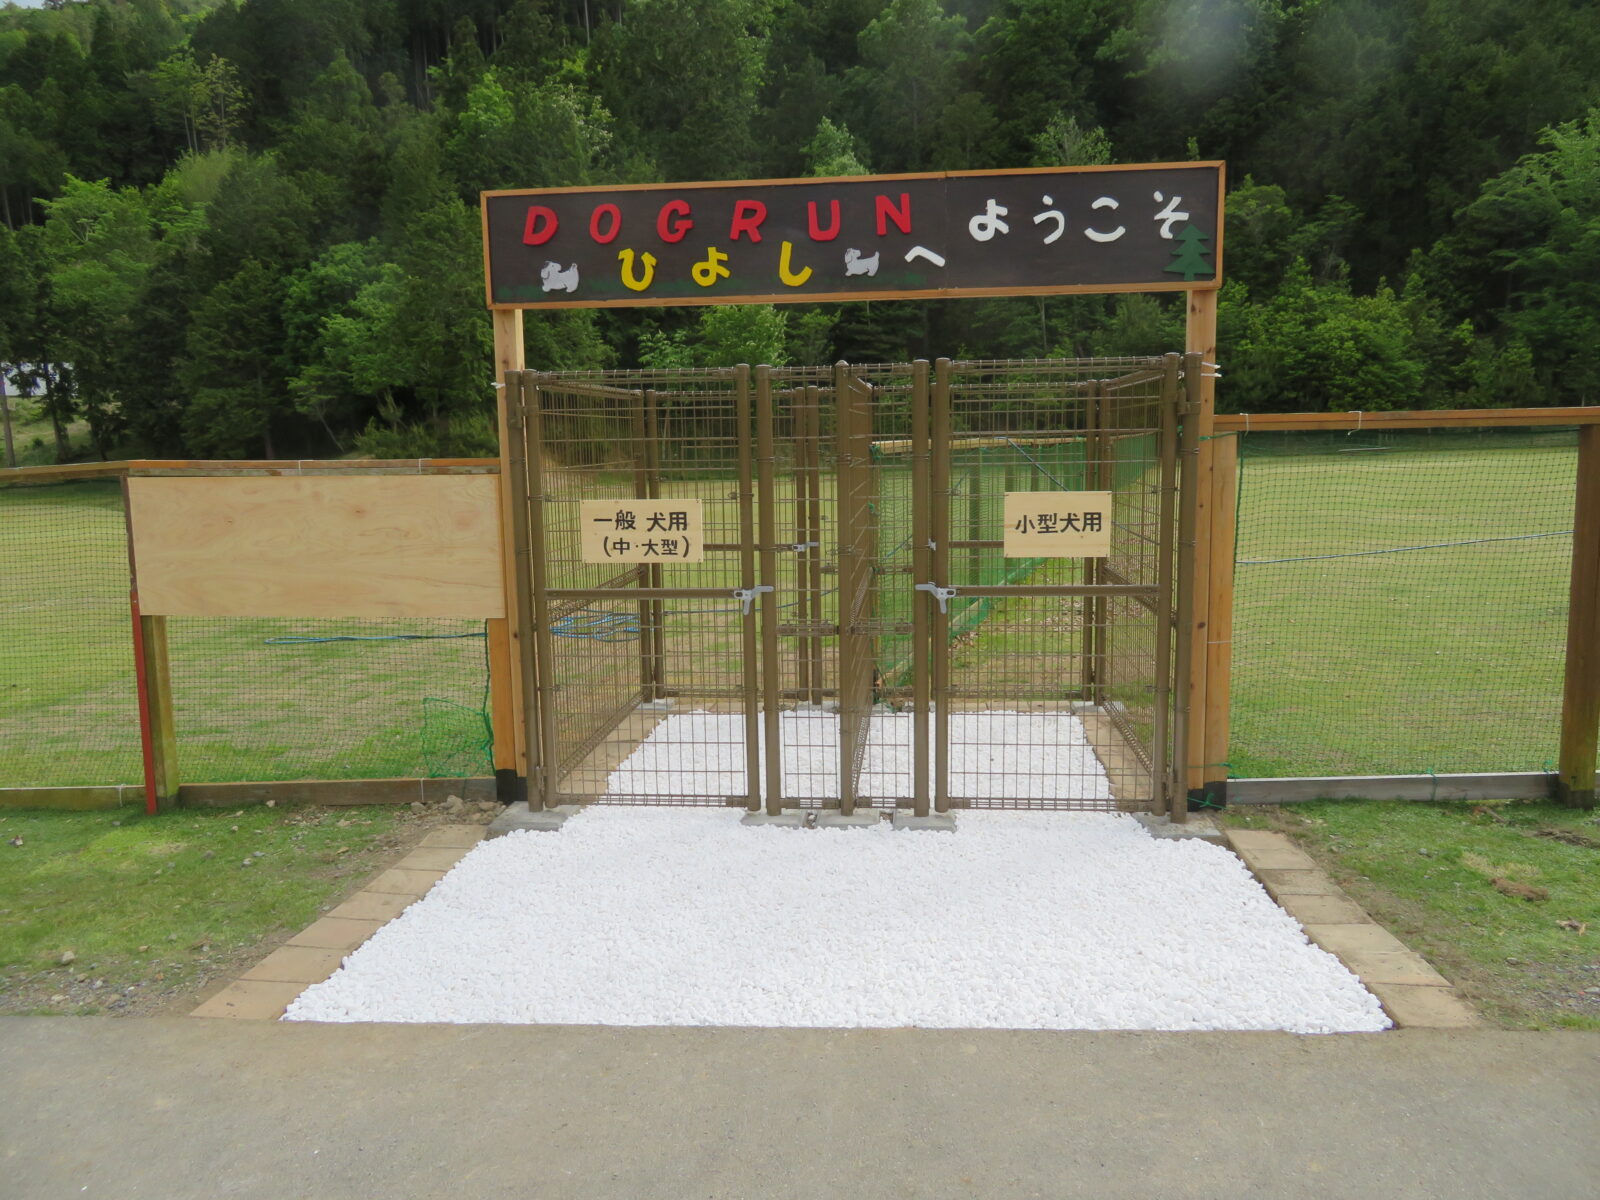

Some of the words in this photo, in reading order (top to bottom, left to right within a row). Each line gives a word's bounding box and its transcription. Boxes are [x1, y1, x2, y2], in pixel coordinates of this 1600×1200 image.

[968, 190, 1190, 244] ようこそ
[904, 245, 946, 268] へ
[1014, 511, 1103, 534] 小型犬用
